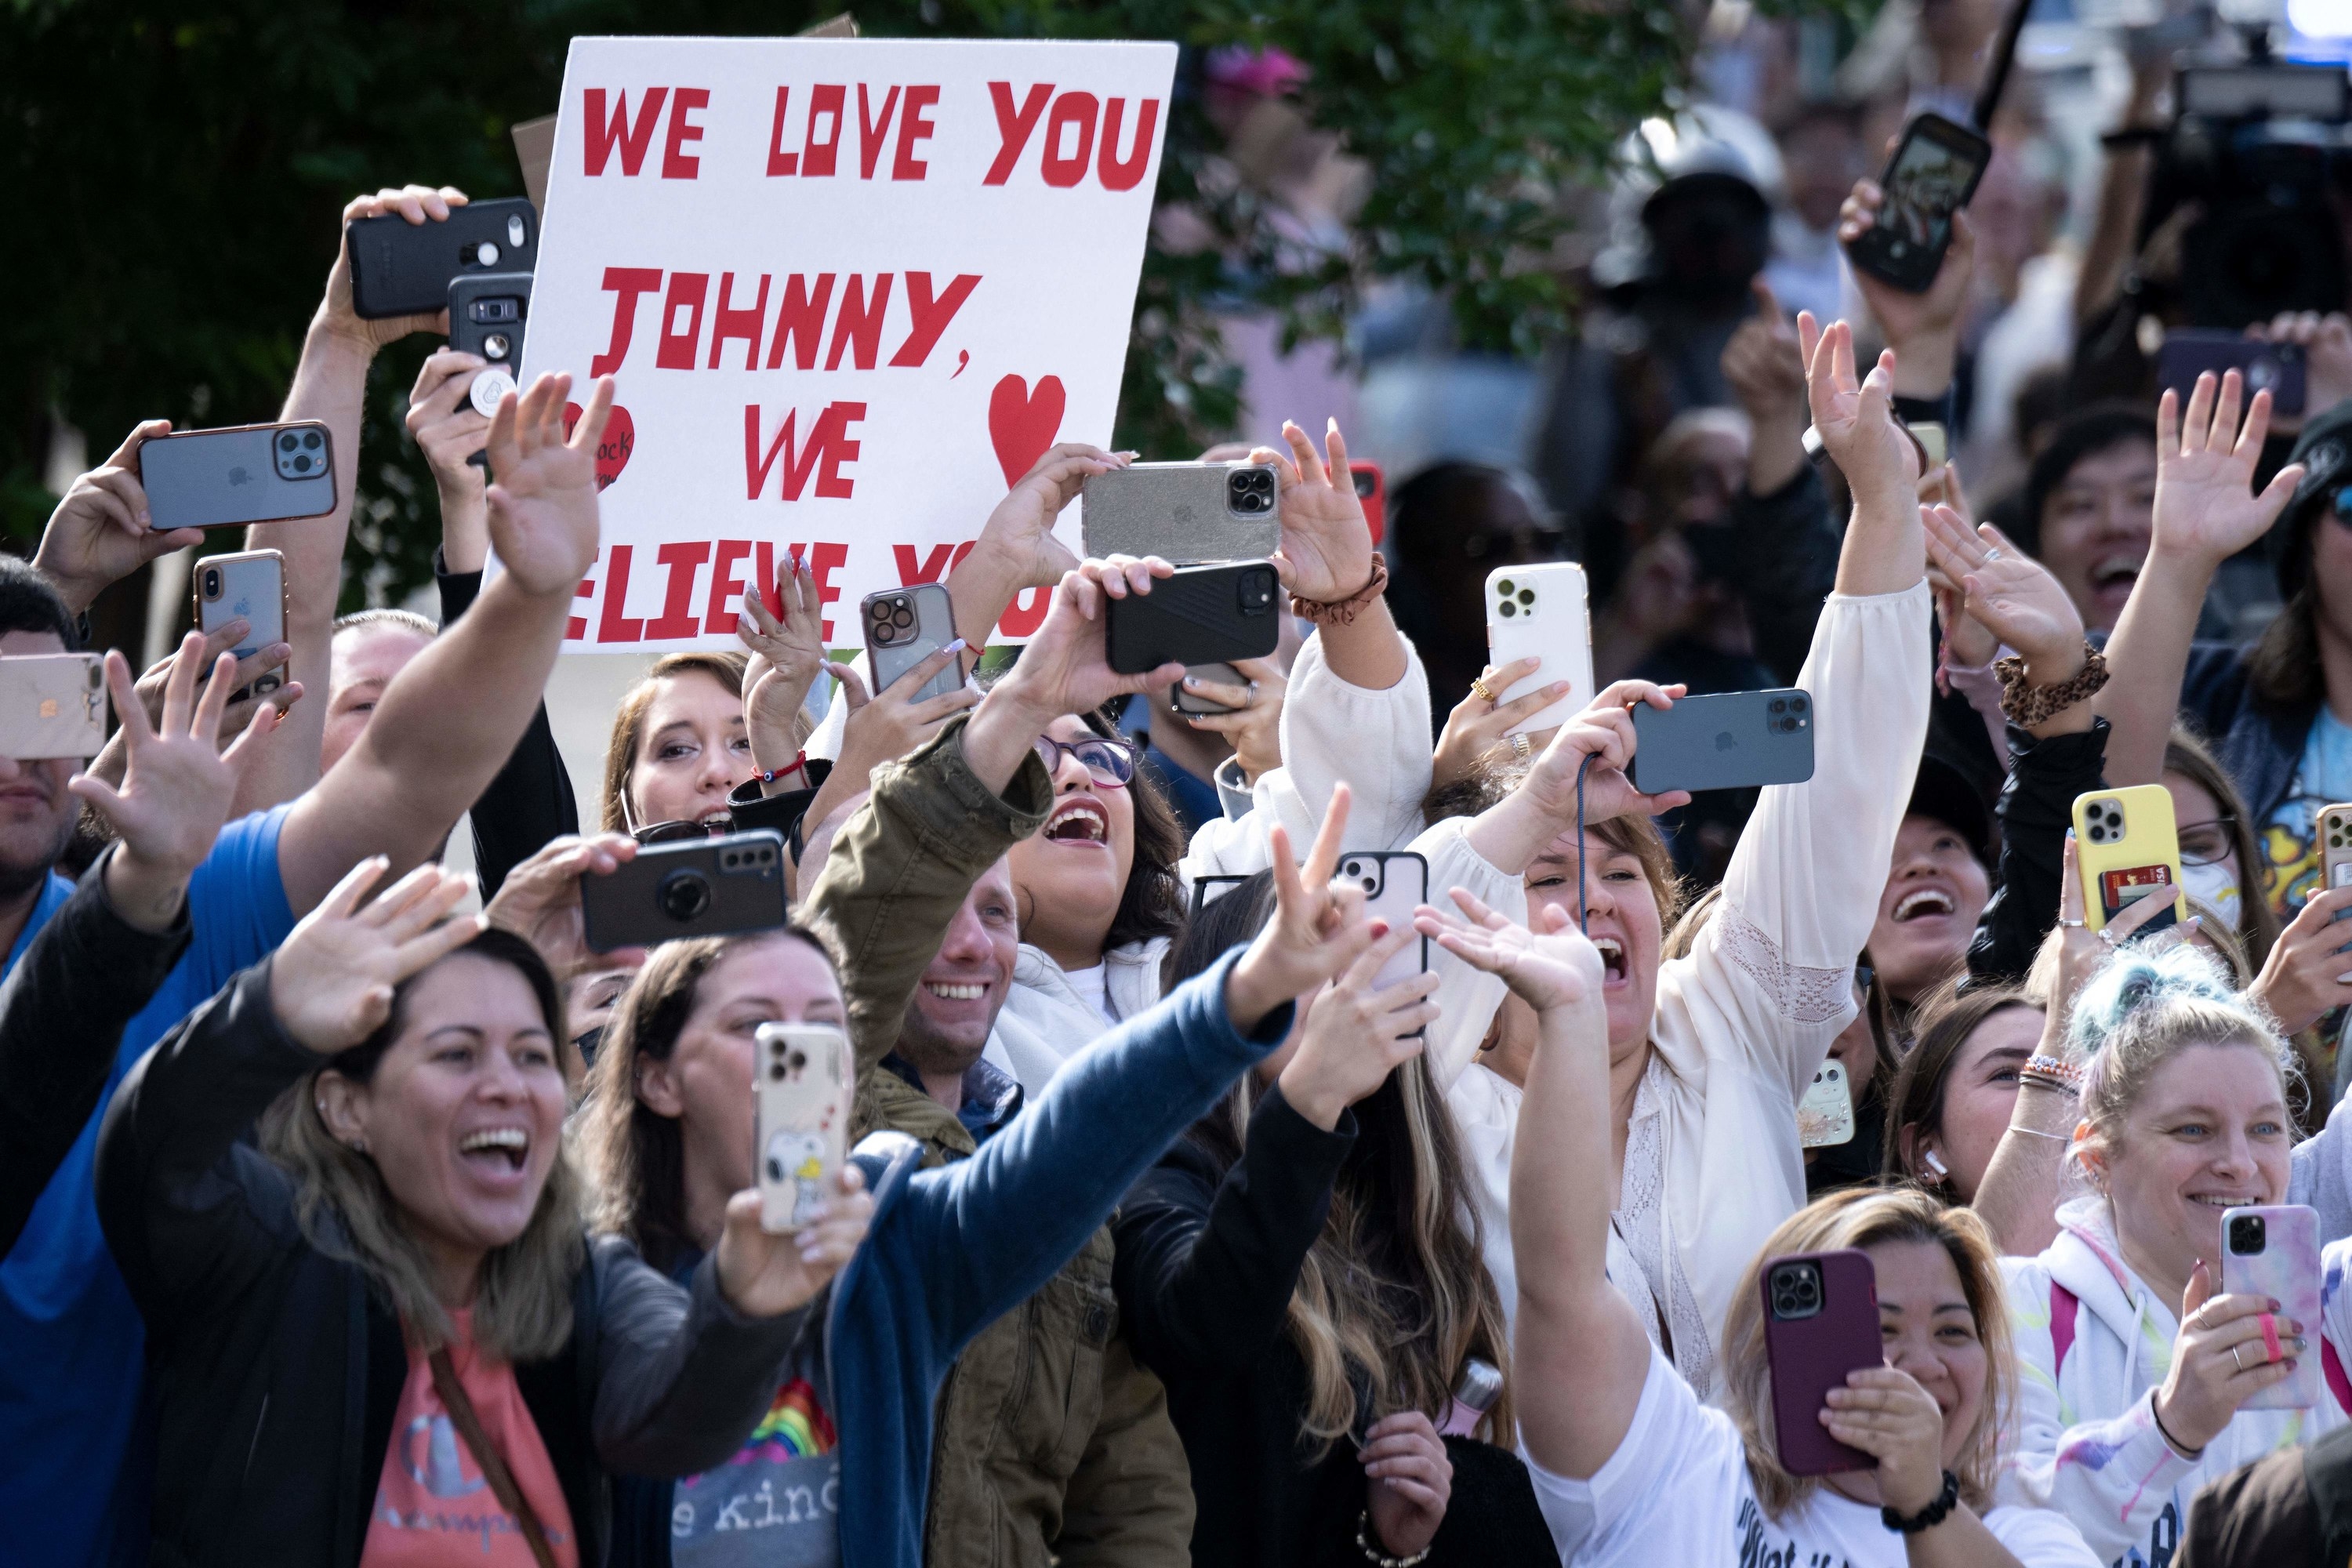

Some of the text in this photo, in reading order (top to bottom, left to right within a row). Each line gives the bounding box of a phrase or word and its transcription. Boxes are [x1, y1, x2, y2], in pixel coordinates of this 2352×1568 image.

[585, 82, 1158, 191] WE LOVE YOU
[592, 267, 982, 379] JOHNNY,
[746, 401, 866, 501] WE
[2155, 866, 2165, 884] ISA
